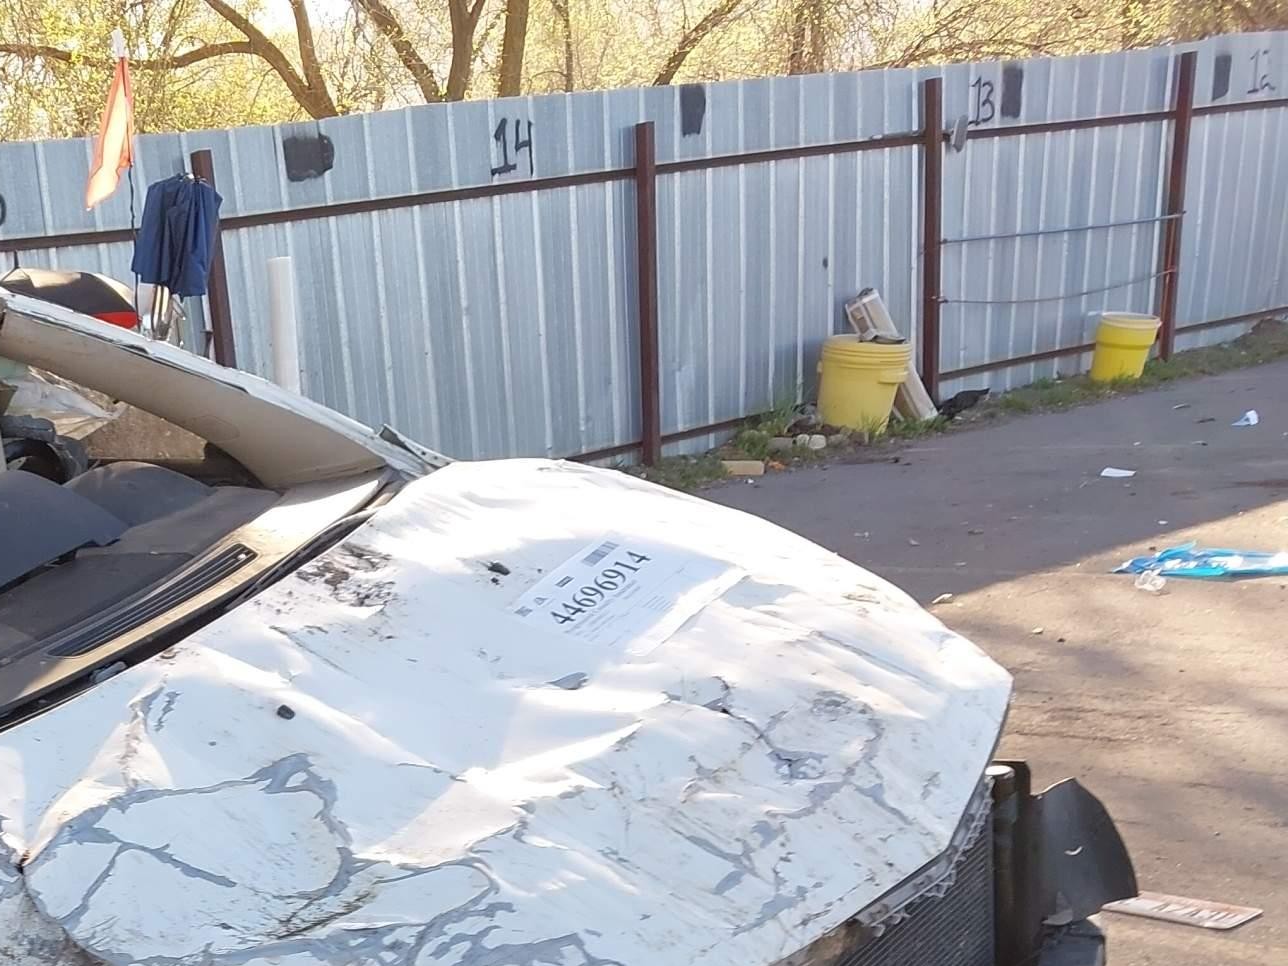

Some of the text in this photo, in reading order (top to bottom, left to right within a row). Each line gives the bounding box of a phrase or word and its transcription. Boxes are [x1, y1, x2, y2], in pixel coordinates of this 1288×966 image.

[968, 75, 995, 127] 13
[491, 117, 533, 176] 14
[549, 550, 651, 626] 44696914
